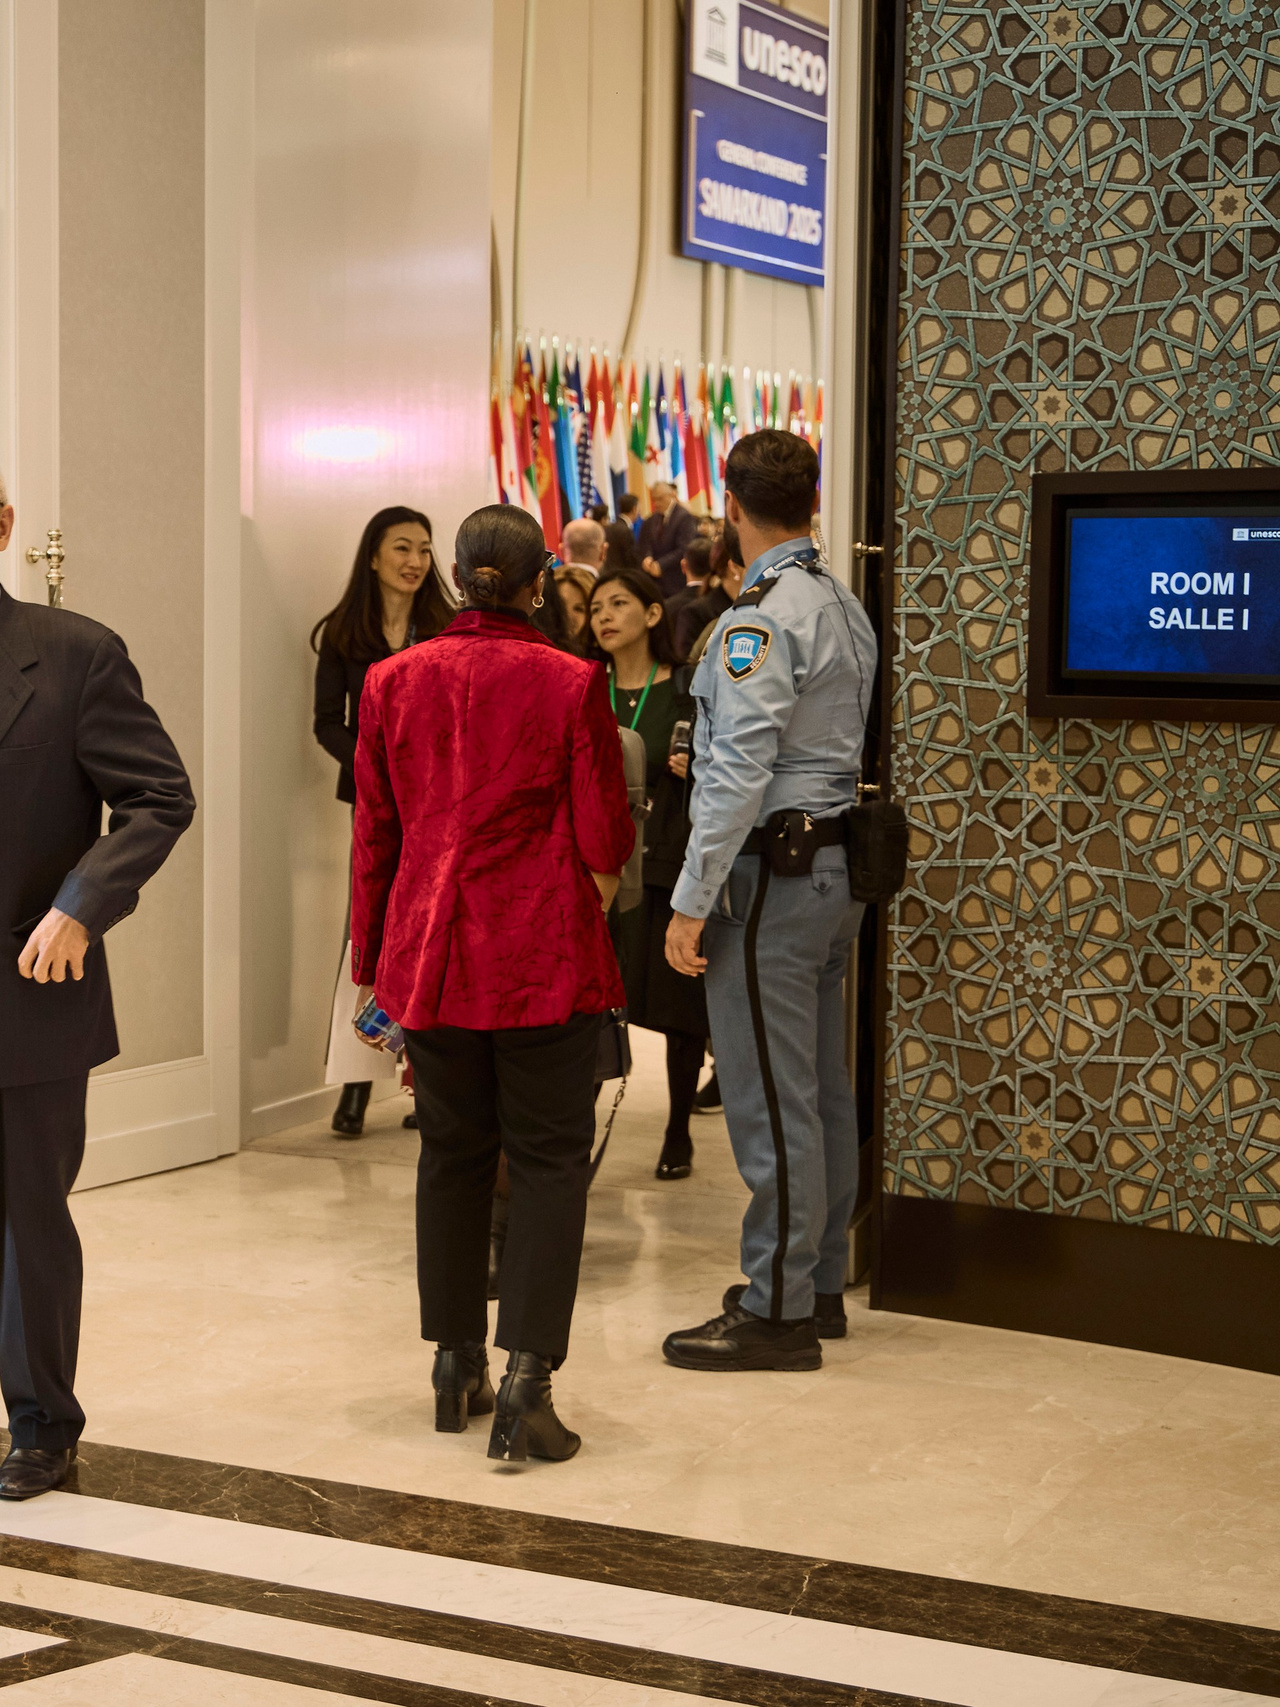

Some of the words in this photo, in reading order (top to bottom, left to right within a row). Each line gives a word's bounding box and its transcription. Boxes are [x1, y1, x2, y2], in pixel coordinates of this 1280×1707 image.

[742, 26, 827, 96] unesco
[698, 177, 788, 237] SAMARKAND
[786, 203, 823, 246] 2025
[1150, 571, 1235, 596] ROOM
[1243, 572, 1251, 596] I
[1148, 606, 1235, 631] SALLE
[1242, 608, 1250, 631] I
